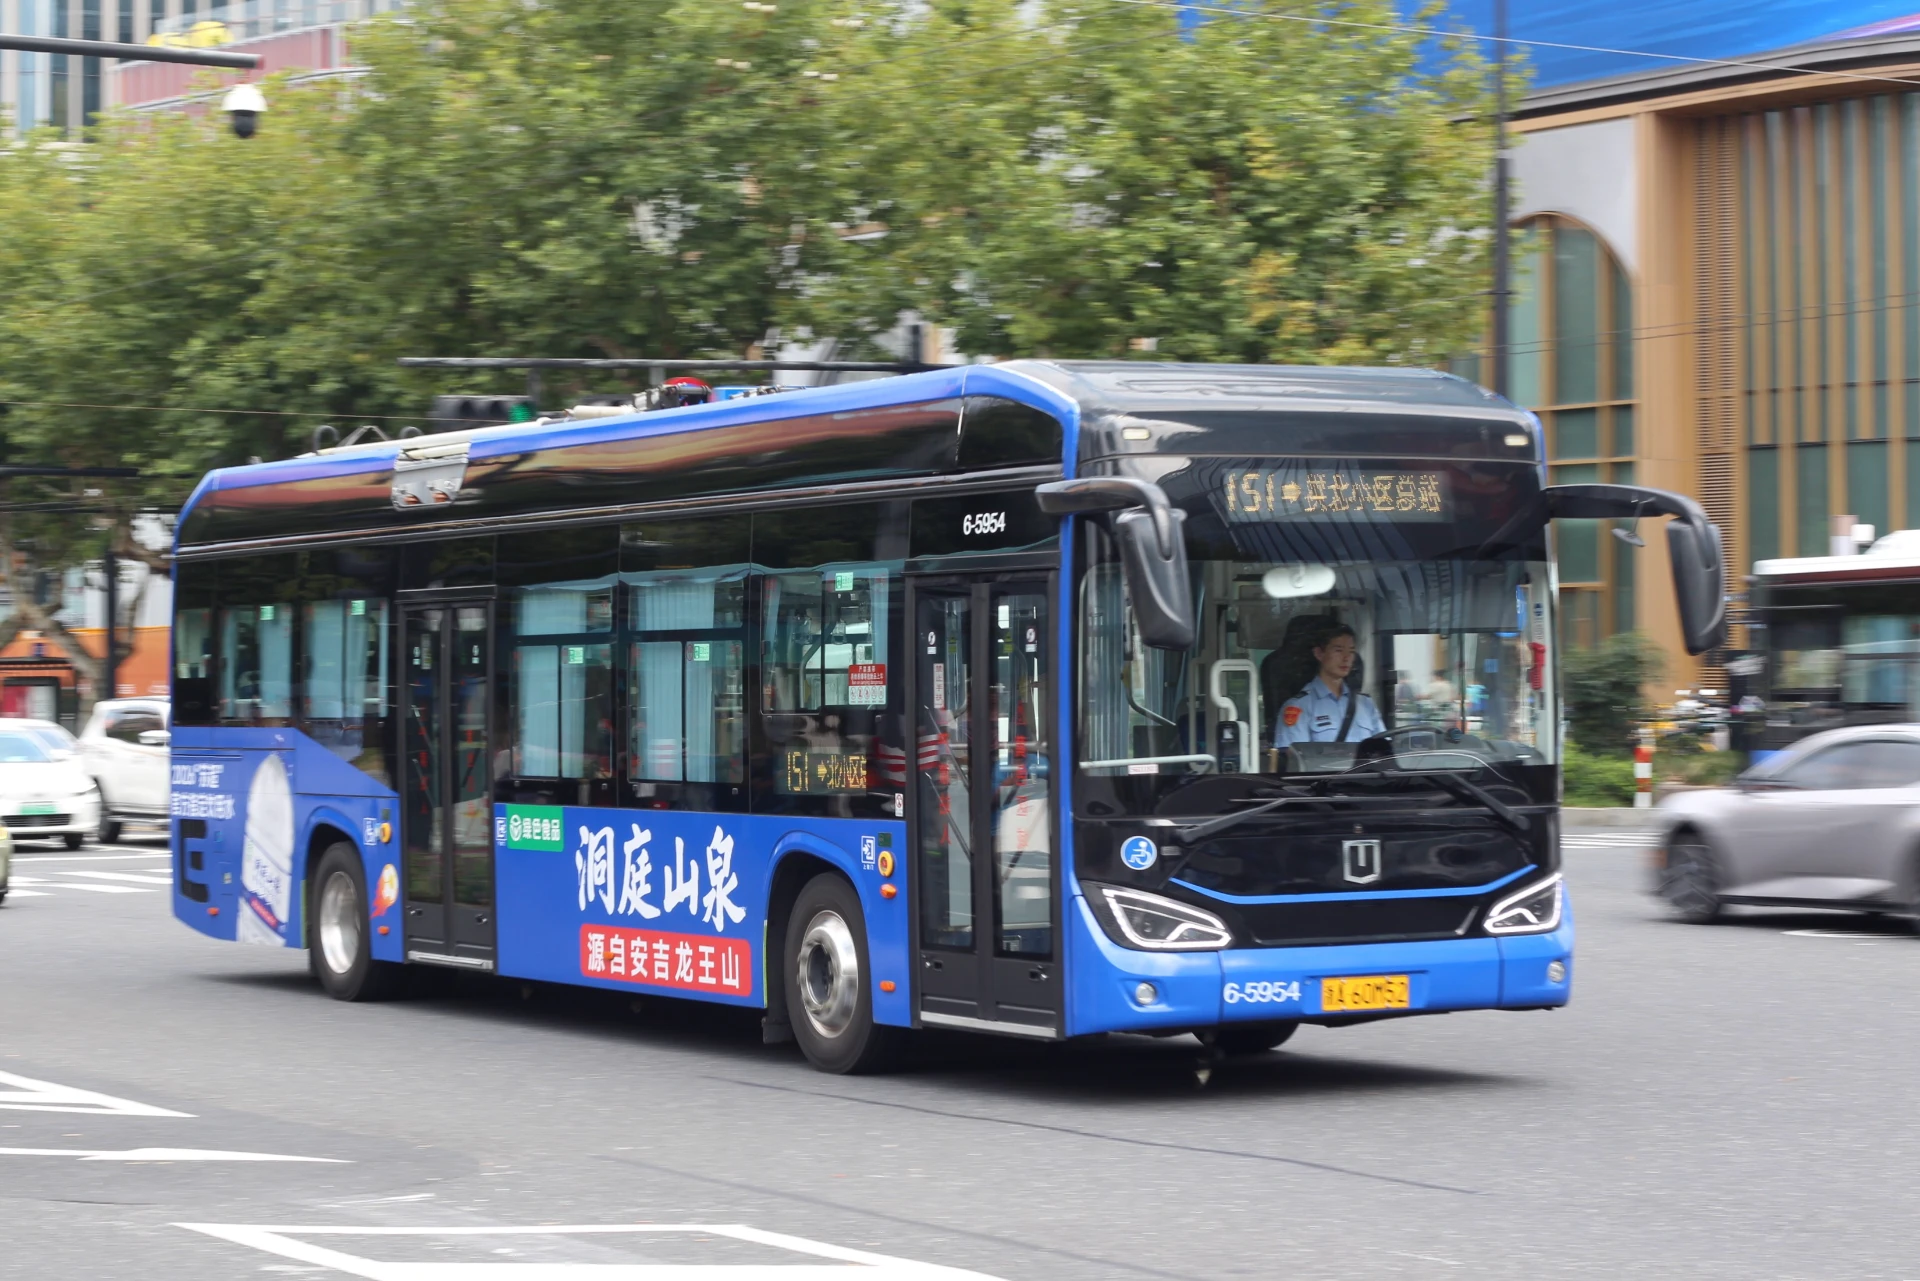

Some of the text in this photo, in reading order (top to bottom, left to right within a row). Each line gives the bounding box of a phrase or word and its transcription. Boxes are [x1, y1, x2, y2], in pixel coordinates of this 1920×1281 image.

[1227, 473, 1275, 512] 151
[963, 511, 1006, 535] 6-5954
[787, 751, 809, 792] 151
[575, 823, 747, 932] 洞庭山泉
[587, 931, 740, 989] 源自安吉龙王山
[1223, 980, 1302, 1004] 6-5954
